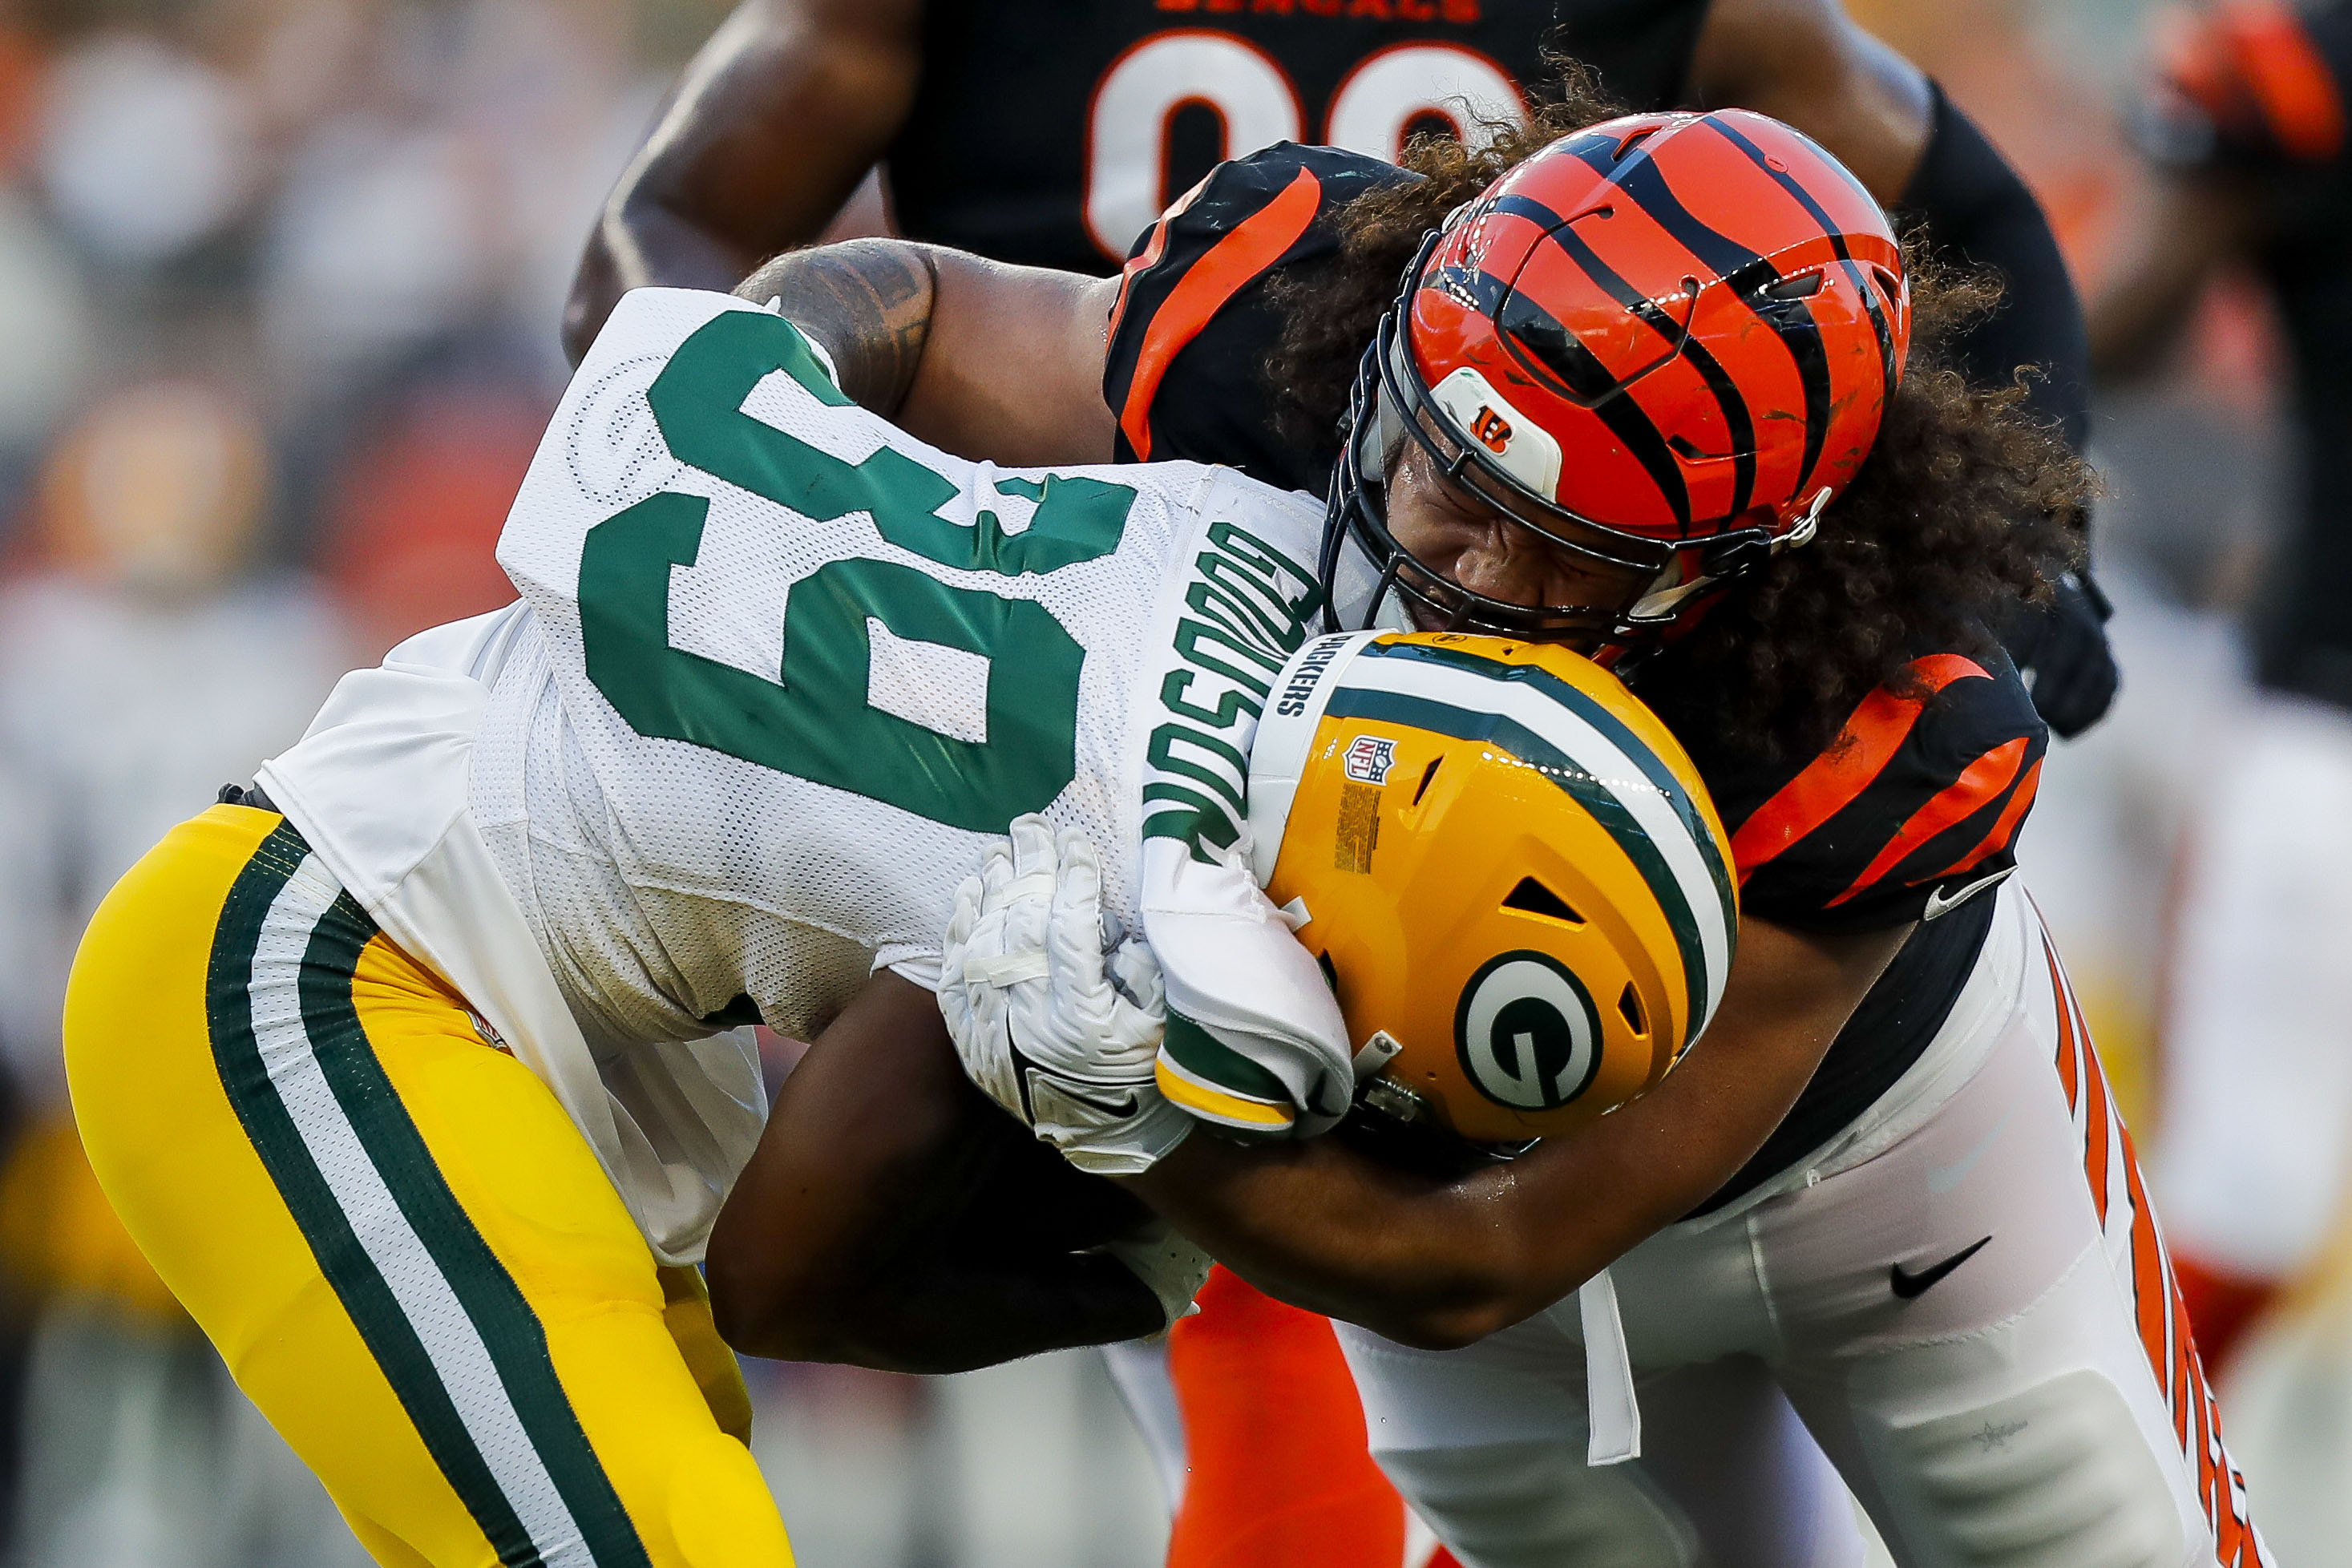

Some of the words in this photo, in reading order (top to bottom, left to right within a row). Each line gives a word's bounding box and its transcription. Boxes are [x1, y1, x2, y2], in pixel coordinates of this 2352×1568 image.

[577, 309, 1138, 835] 39
[1142, 521, 1323, 867] GOODSON
[1276, 635, 1356, 717] PACKERS
[1350, 741, 1376, 774] NFL
[1464, 958, 1594, 1109] G
